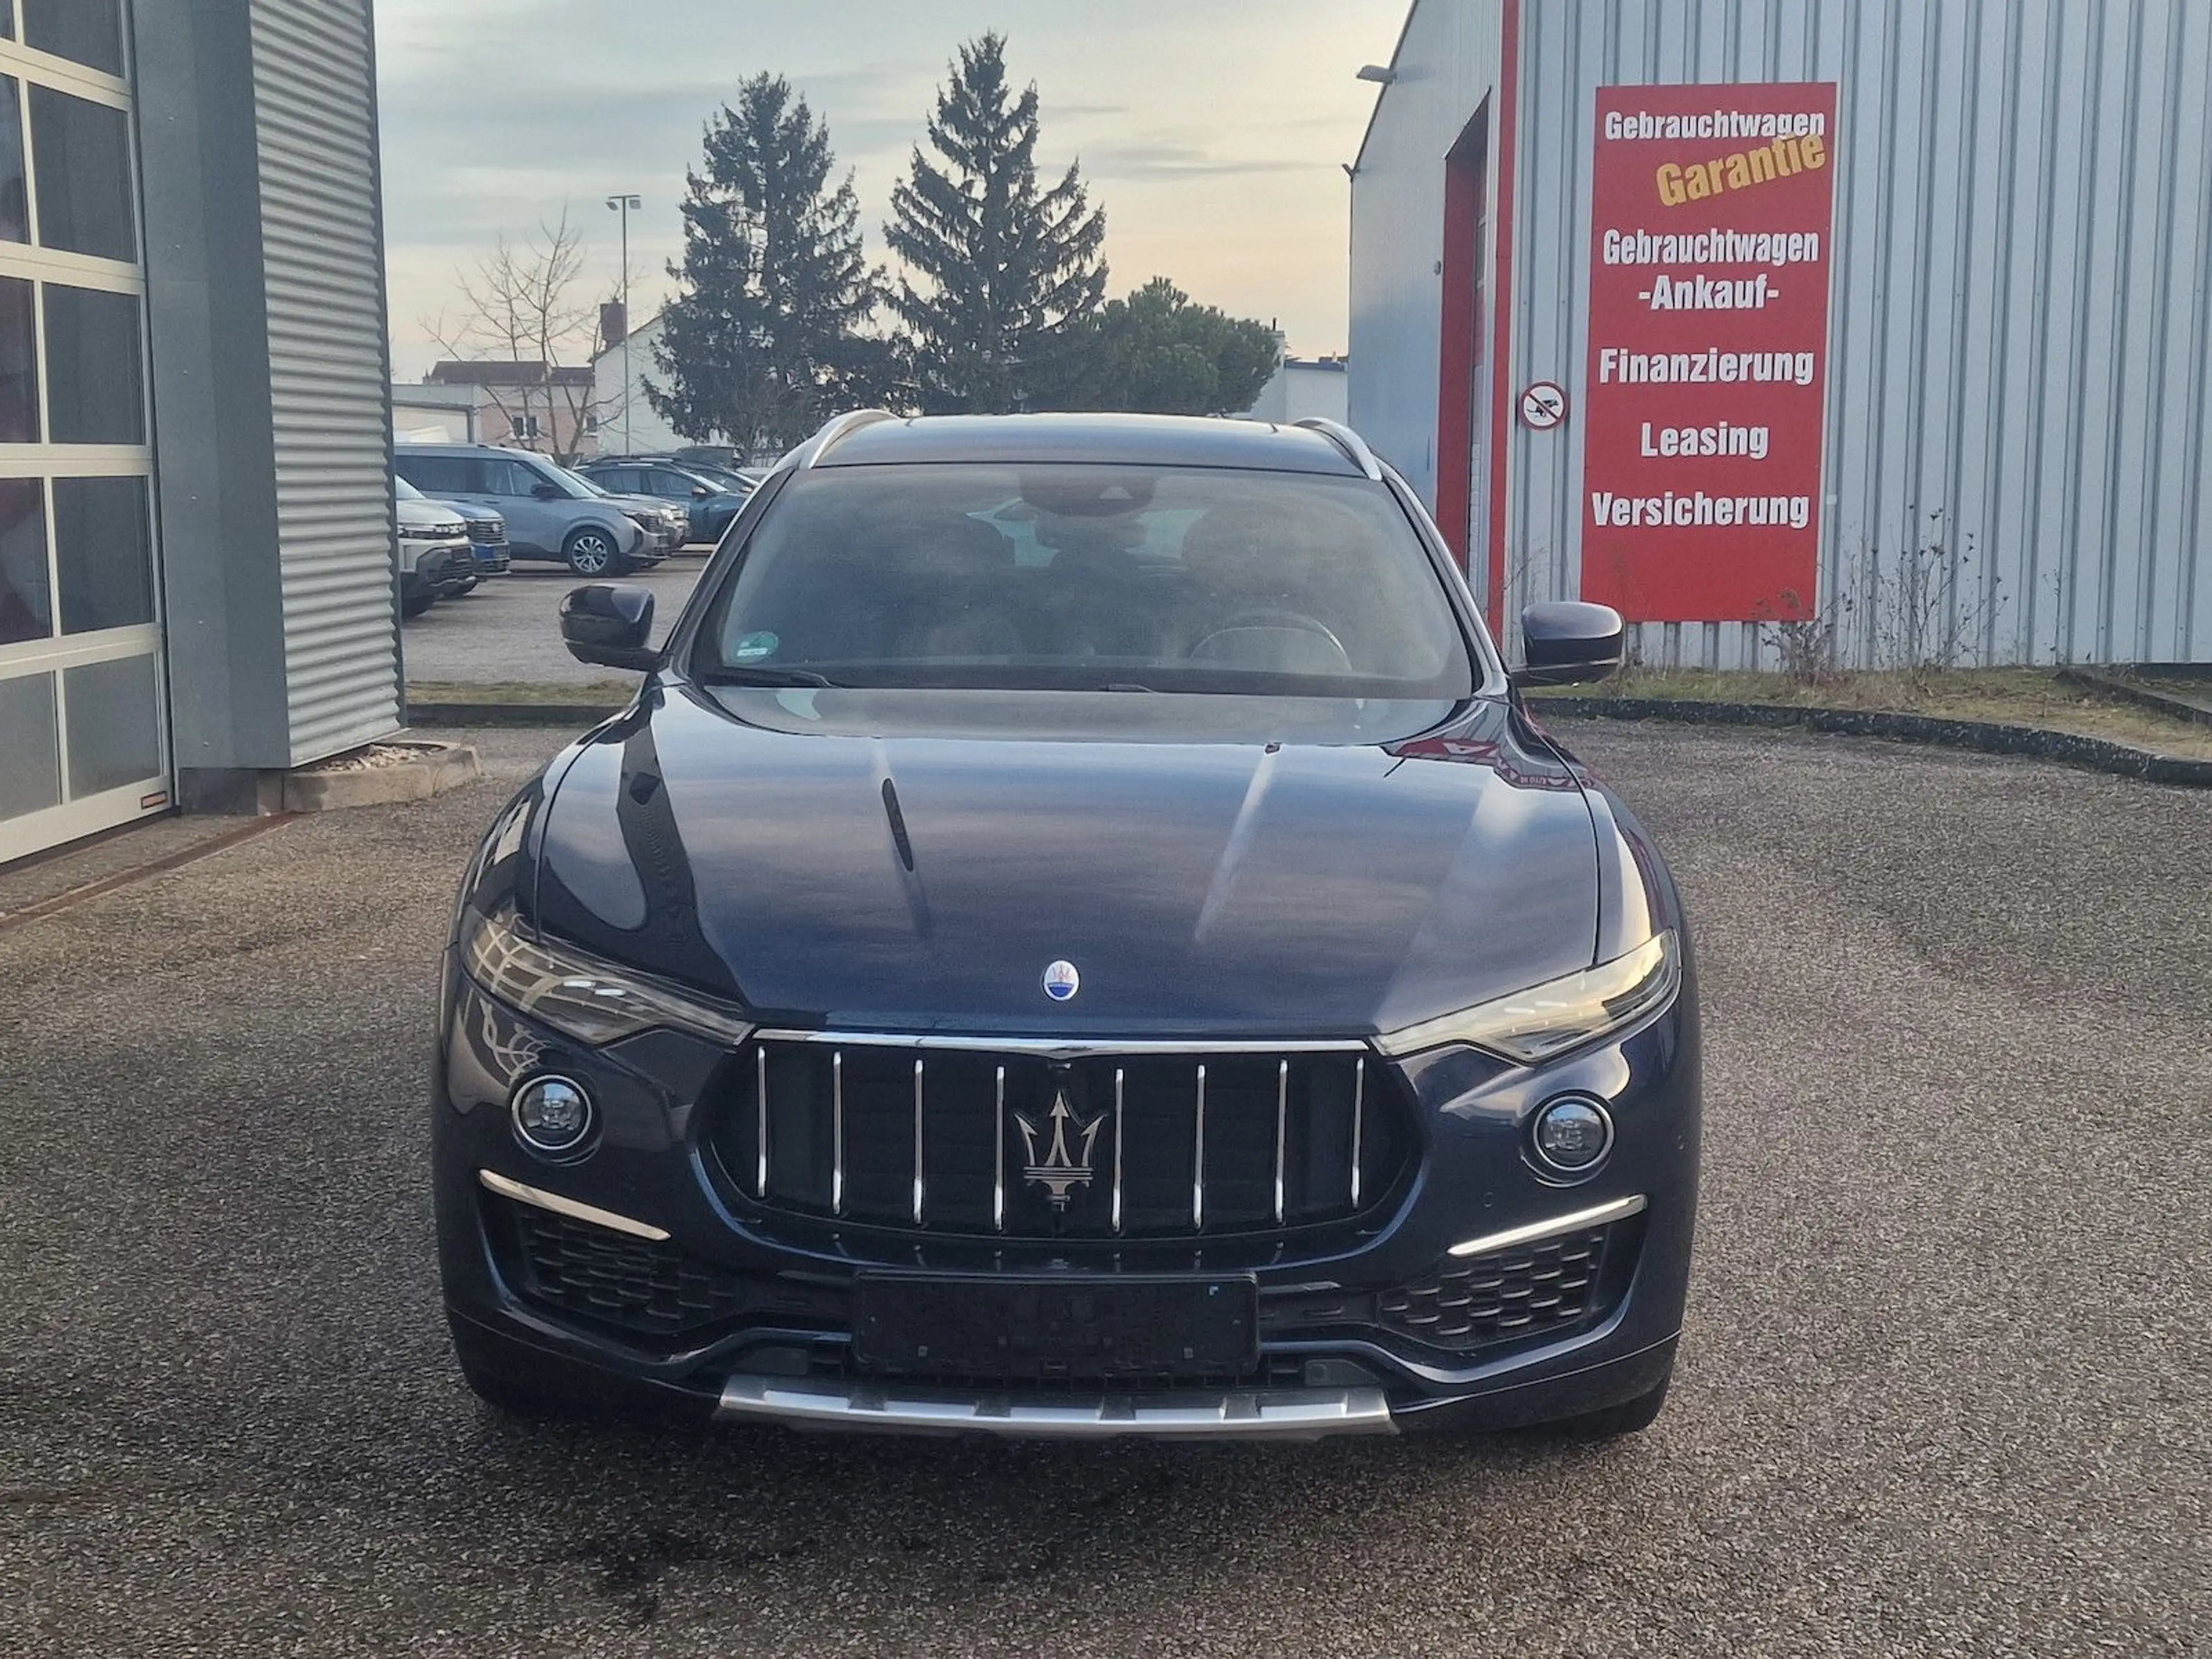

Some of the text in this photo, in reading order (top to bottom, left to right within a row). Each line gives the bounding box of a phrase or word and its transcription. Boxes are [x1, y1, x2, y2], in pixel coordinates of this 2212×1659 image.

[1605, 110, 1825, 140] Gebrauchtwagen
[1656, 132, 1825, 206] Garantie
[1603, 228, 1819, 266] Gebrauchtwagen
[1638, 274, 1779, 310] -Ankauf-
[1599, 347, 1815, 385] Finanzierung
[1641, 421, 1769, 459] Leasing
[1592, 491, 1809, 529] Versicherung
